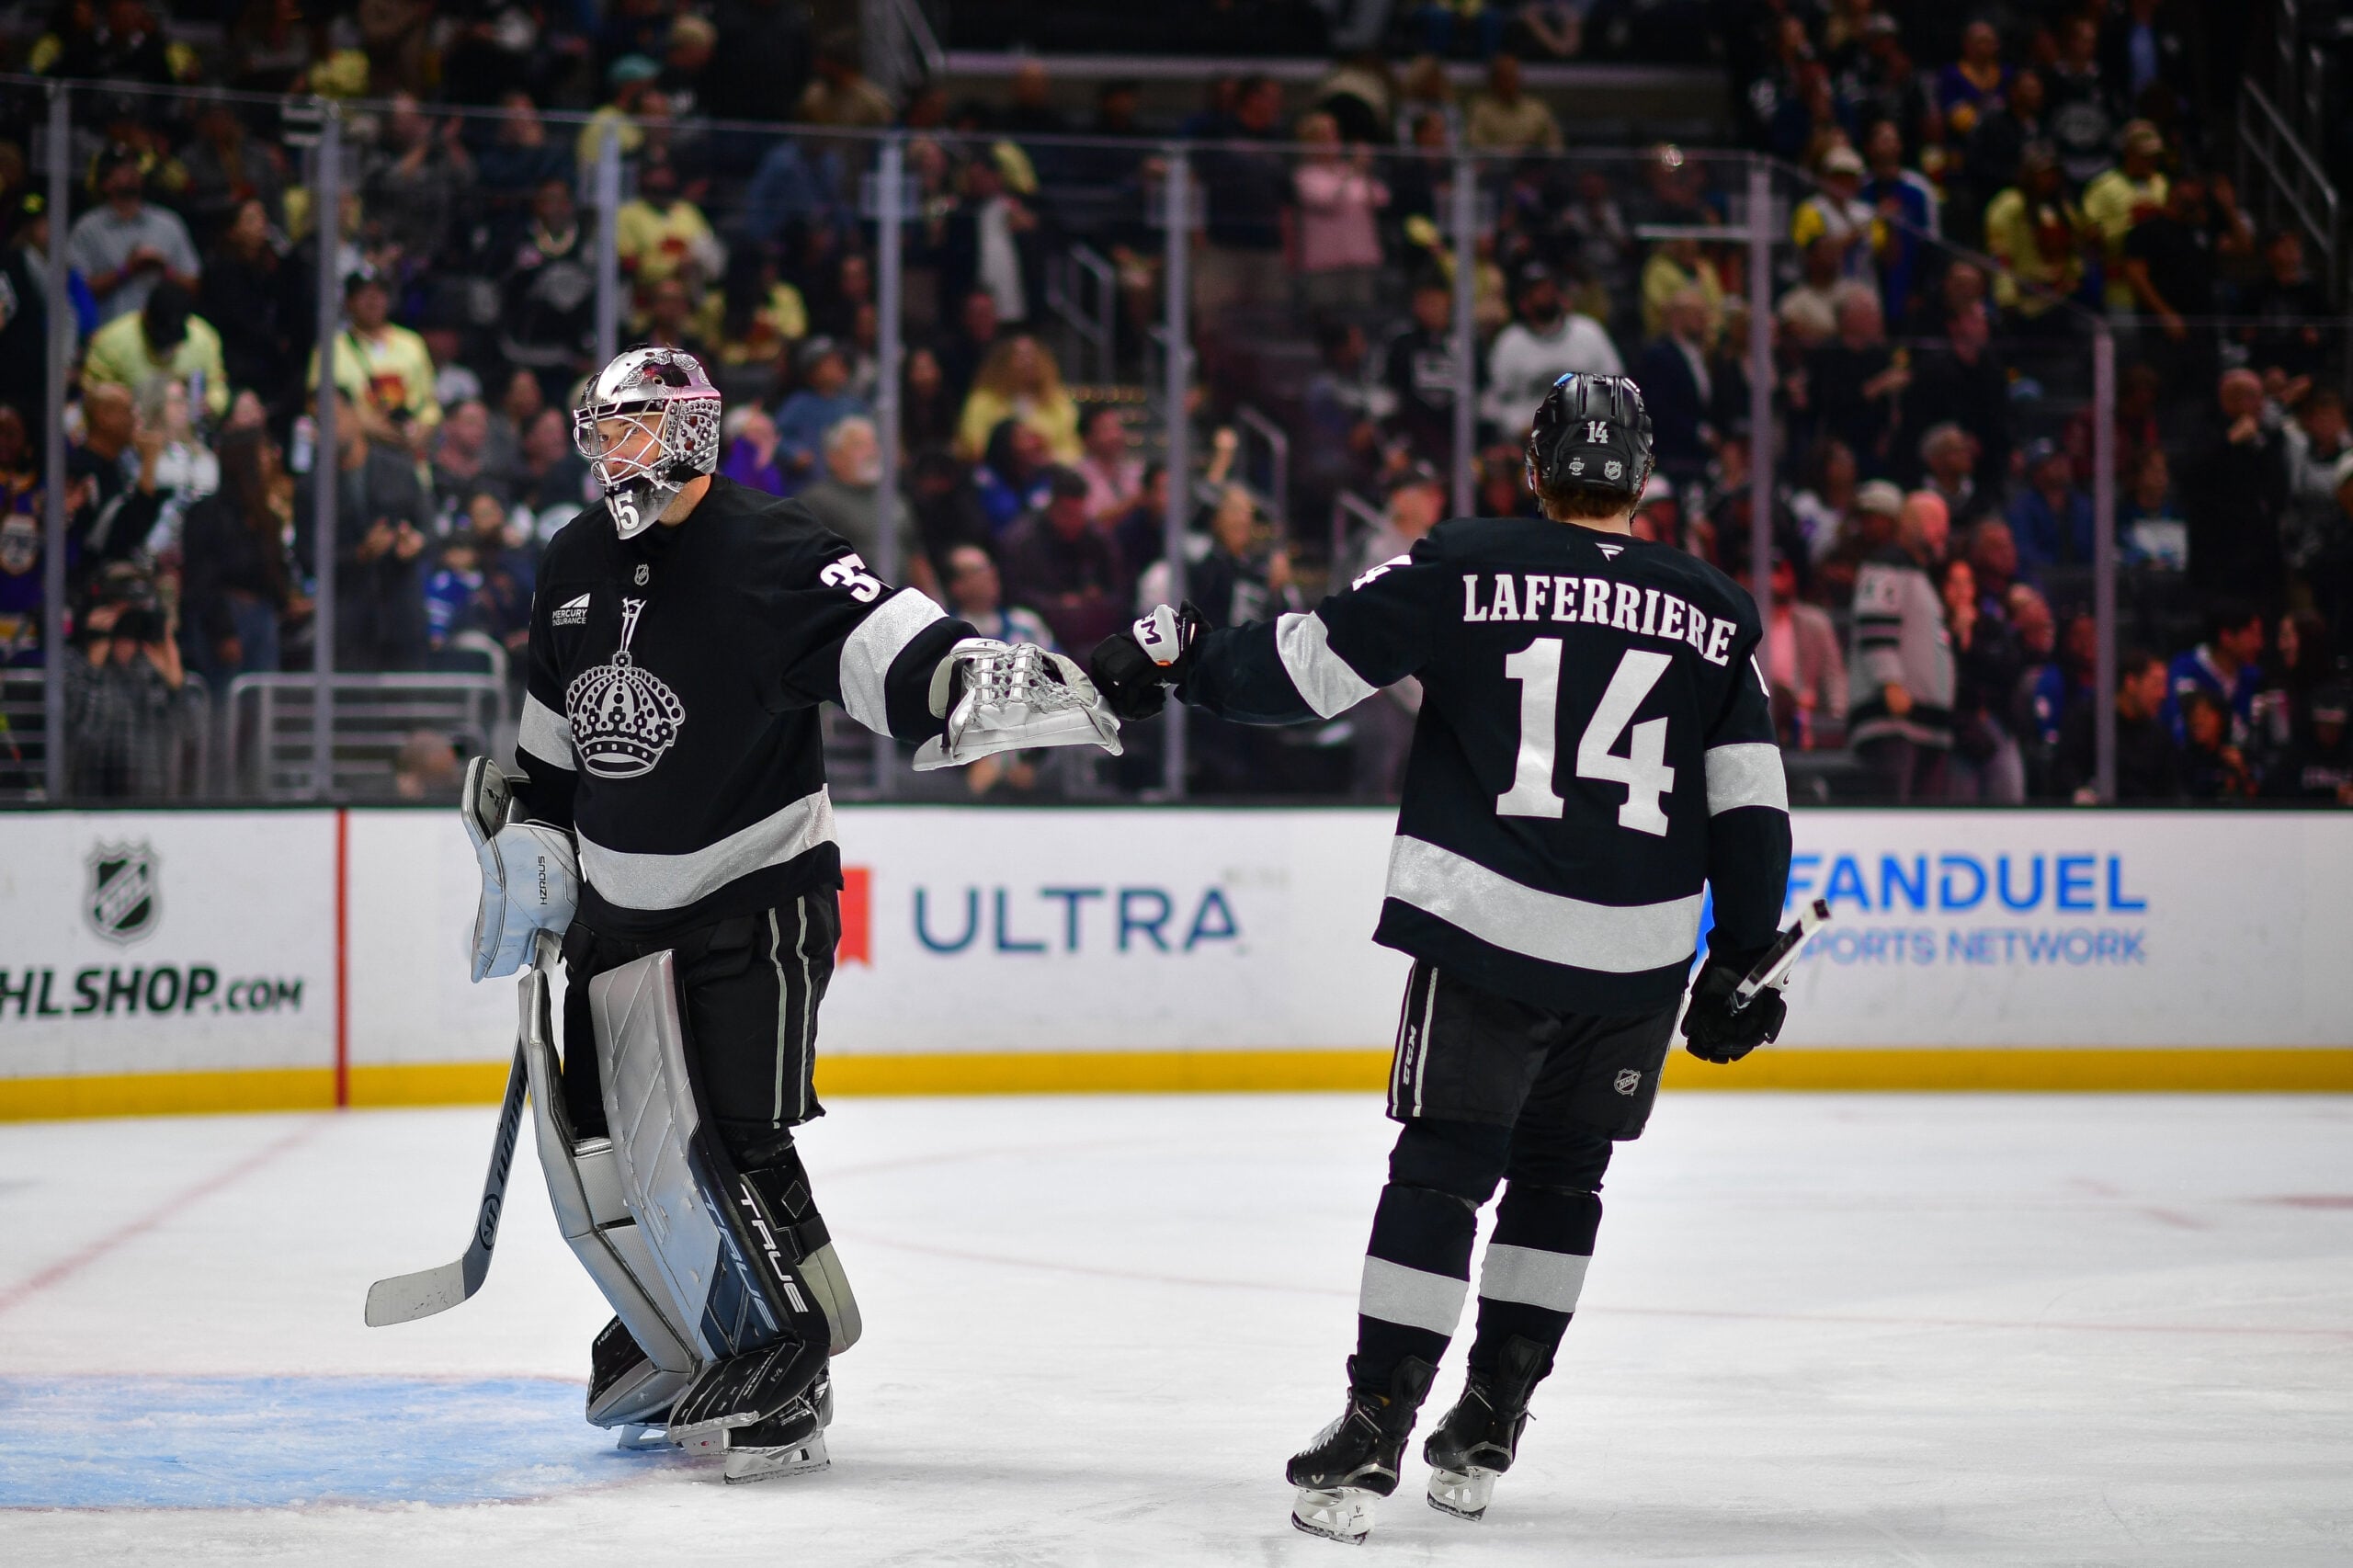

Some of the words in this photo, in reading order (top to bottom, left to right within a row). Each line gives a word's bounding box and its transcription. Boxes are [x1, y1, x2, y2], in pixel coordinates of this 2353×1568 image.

[1586, 420, 1608, 444] 14
[820, 553, 881, 602] 35
[552, 608, 587, 619] MERCURY
[552, 617, 587, 626] INSURANCE
[1462, 574, 1737, 667] LAFERRIERE
[1495, 637, 1675, 836] 14
[1784, 853, 2147, 912] FANDUEL
[913, 885, 1240, 954] ULTRA
[1802, 927, 1936, 964] PORTS
[1948, 927, 2147, 964] NETWORK
[703, 1185, 779, 1333] TRUE
[740, 1182, 810, 1313] TRUE
